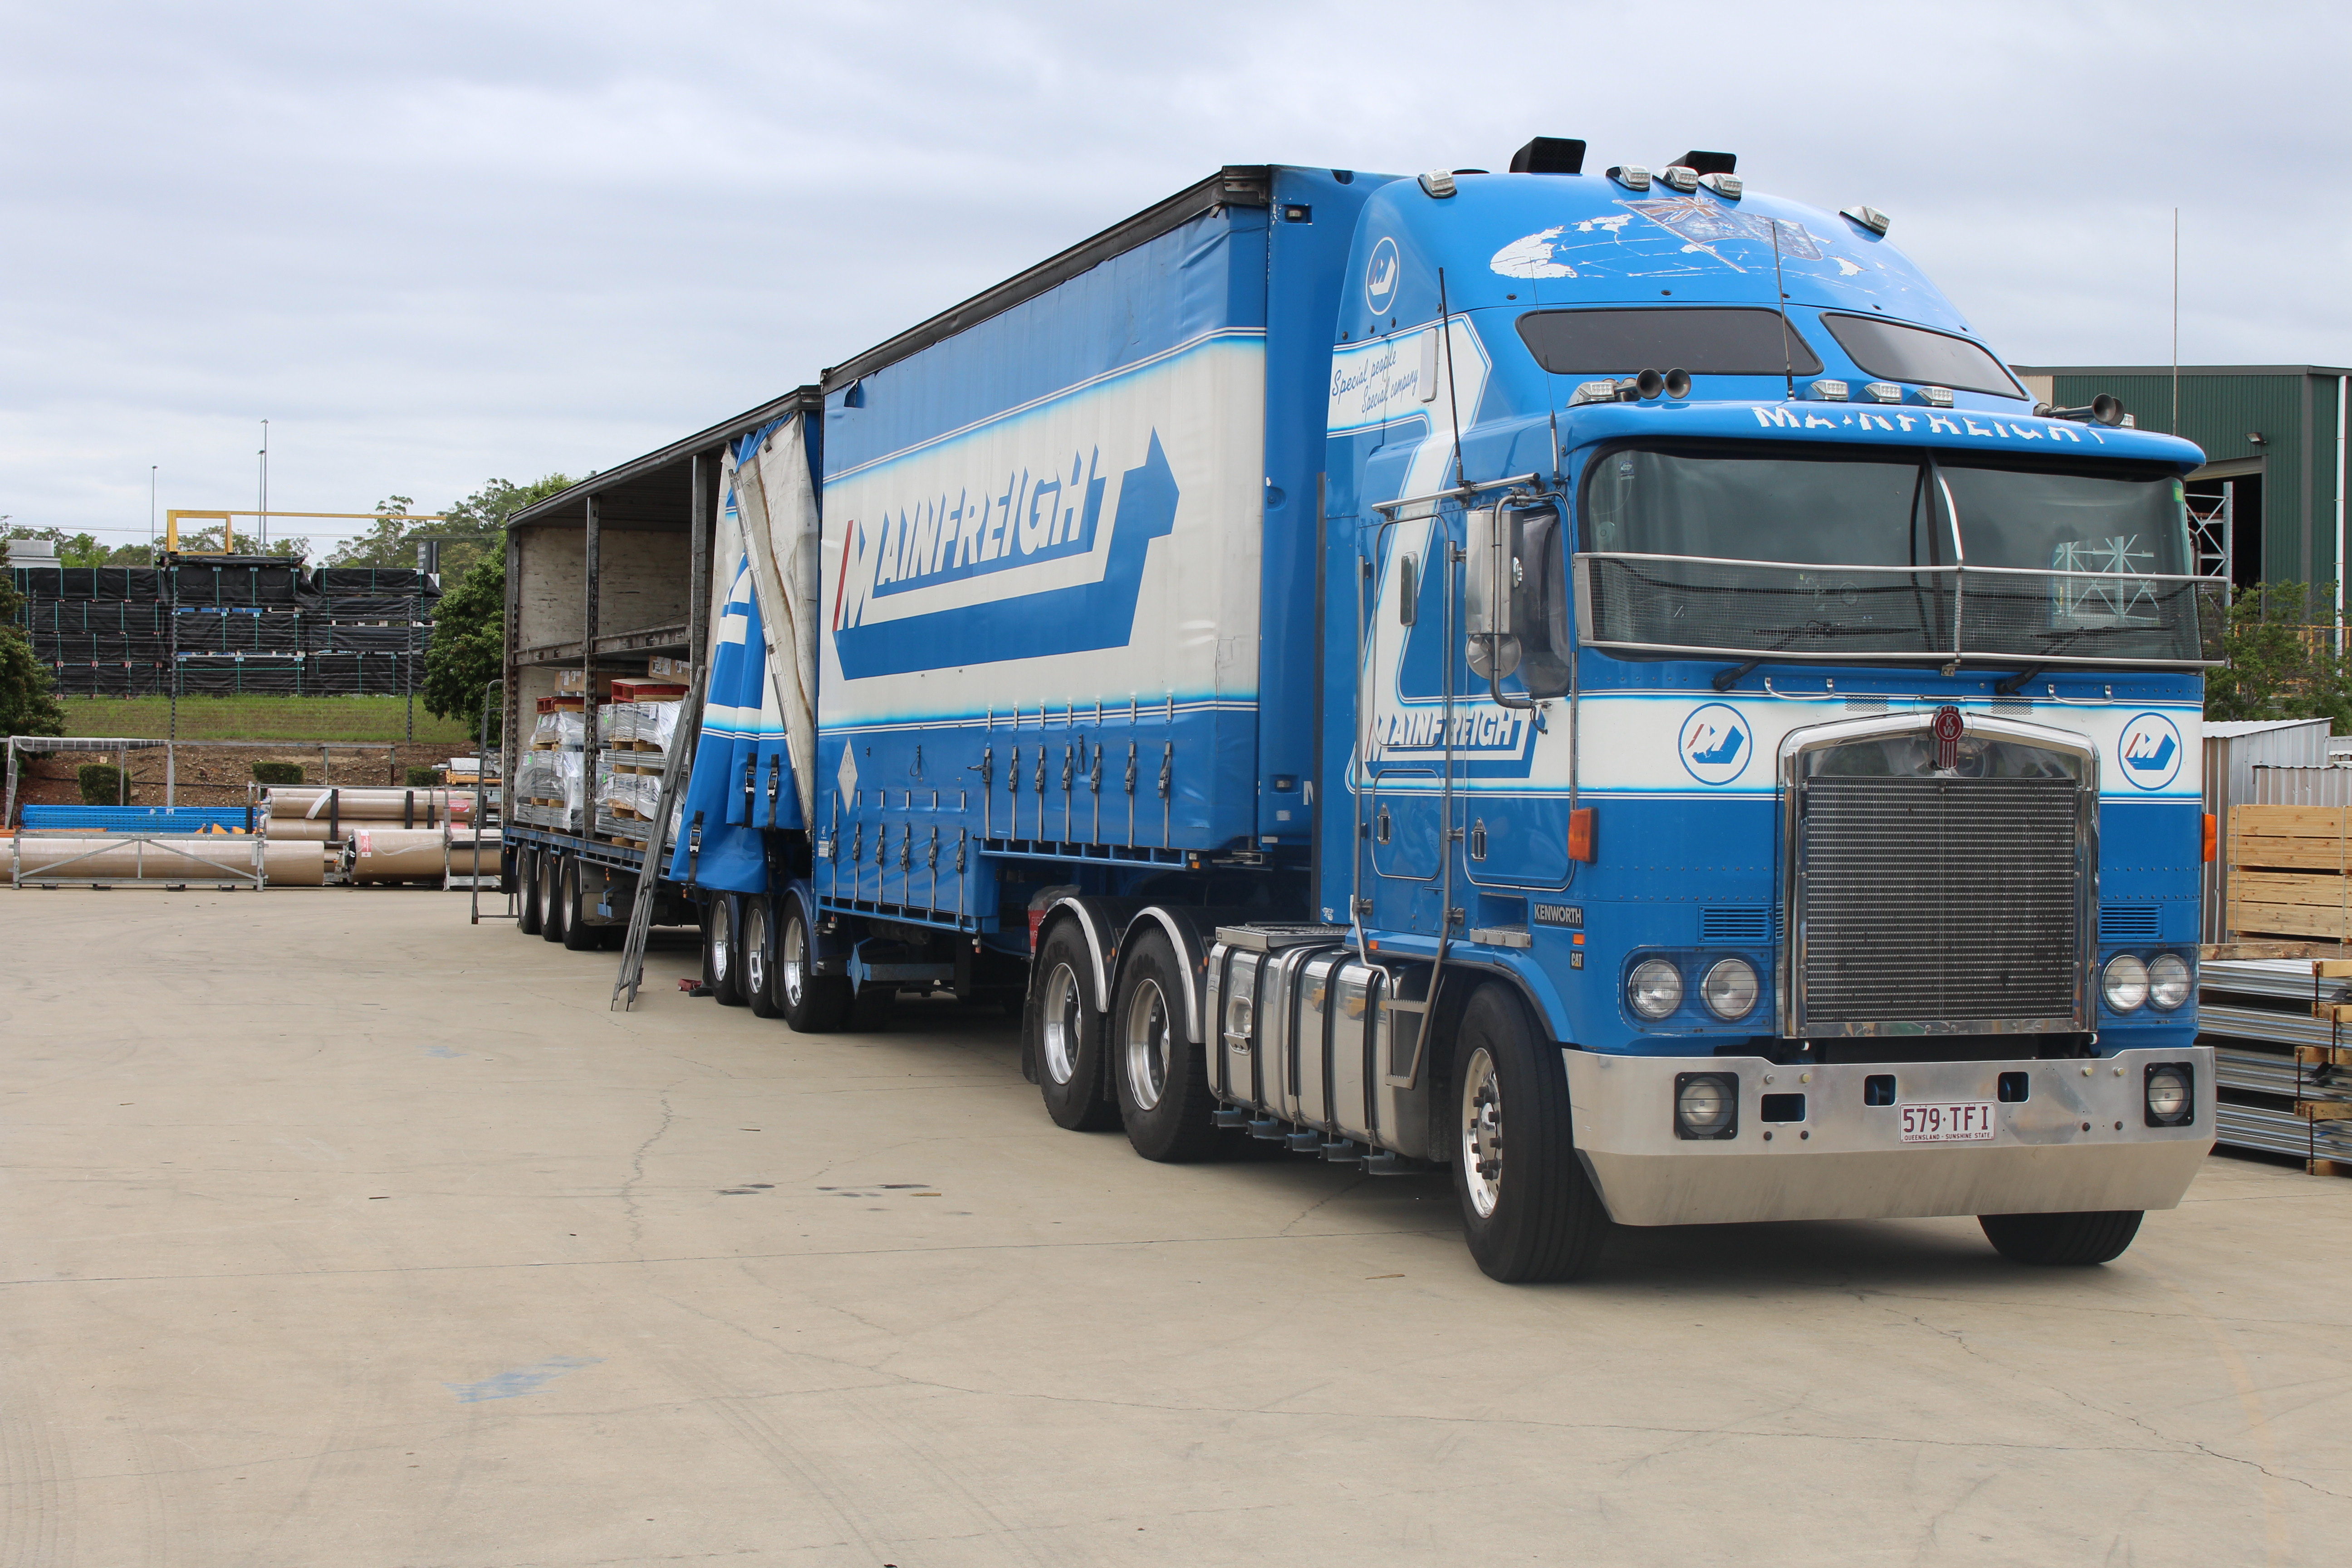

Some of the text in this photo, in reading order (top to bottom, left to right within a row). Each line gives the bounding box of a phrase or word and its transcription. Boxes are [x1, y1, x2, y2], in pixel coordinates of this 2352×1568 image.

[1332, 343, 1396, 405] Special people
[1362, 369, 1418, 422] Special company
[1751, 407, 2104, 444] MANFREIGH
[833, 445, 1137, 632] MAINFREIGHT
[1365, 709, 1534, 762] MAINFREIGHT
[1534, 904, 1582, 924] KENWORTH
[1571, 953, 1583, 967] CAT
